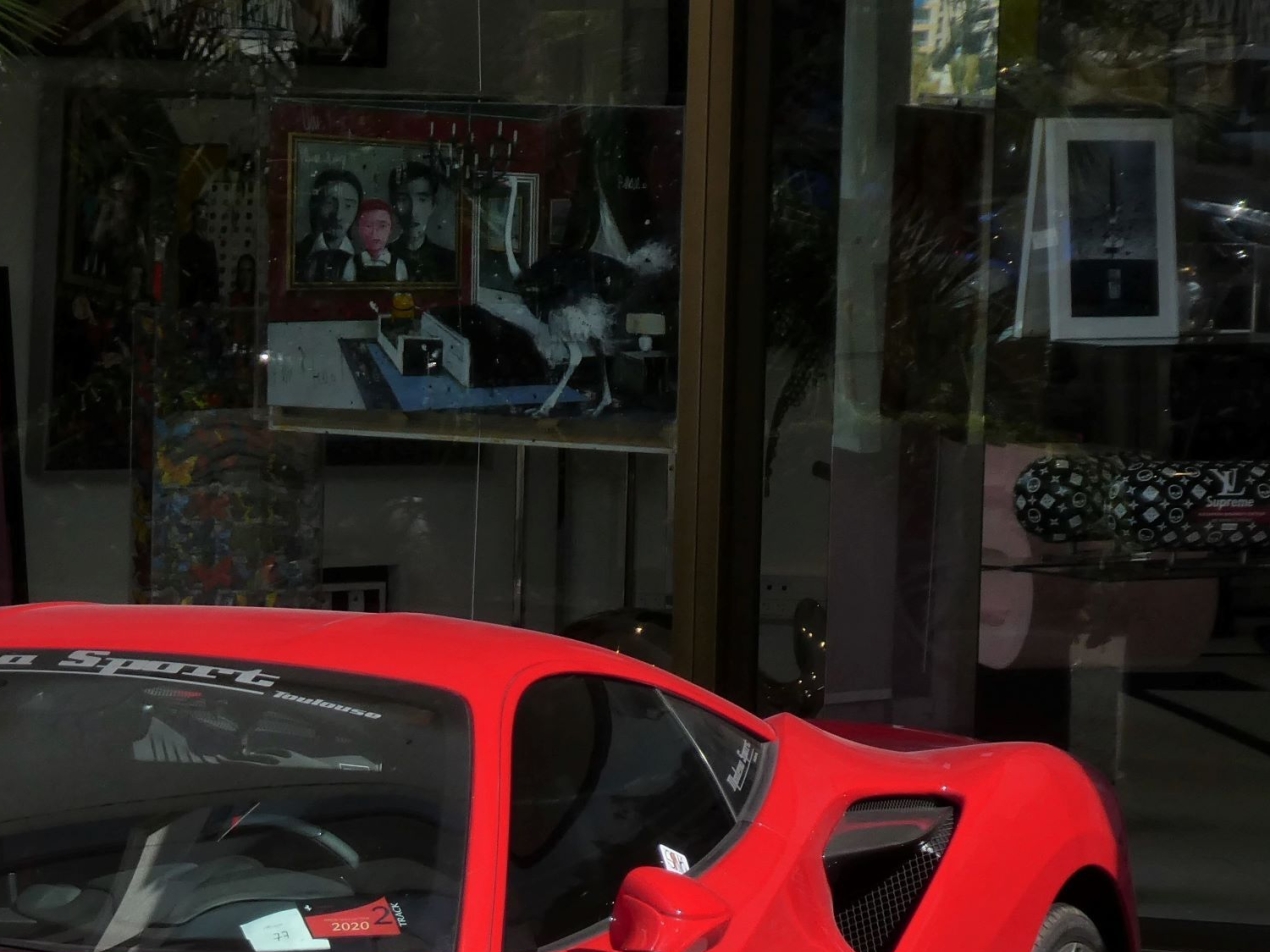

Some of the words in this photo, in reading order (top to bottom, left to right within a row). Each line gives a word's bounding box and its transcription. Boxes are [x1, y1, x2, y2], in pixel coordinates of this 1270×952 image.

[1205, 495, 1255, 510] Supreme
[58, 650, 281, 688] Sport
[272, 690, 382, 720] Toulouse
[372, 906, 393, 925] 2
[390, 902, 407, 927] TRACK
[331, 921, 370, 932] 2020
